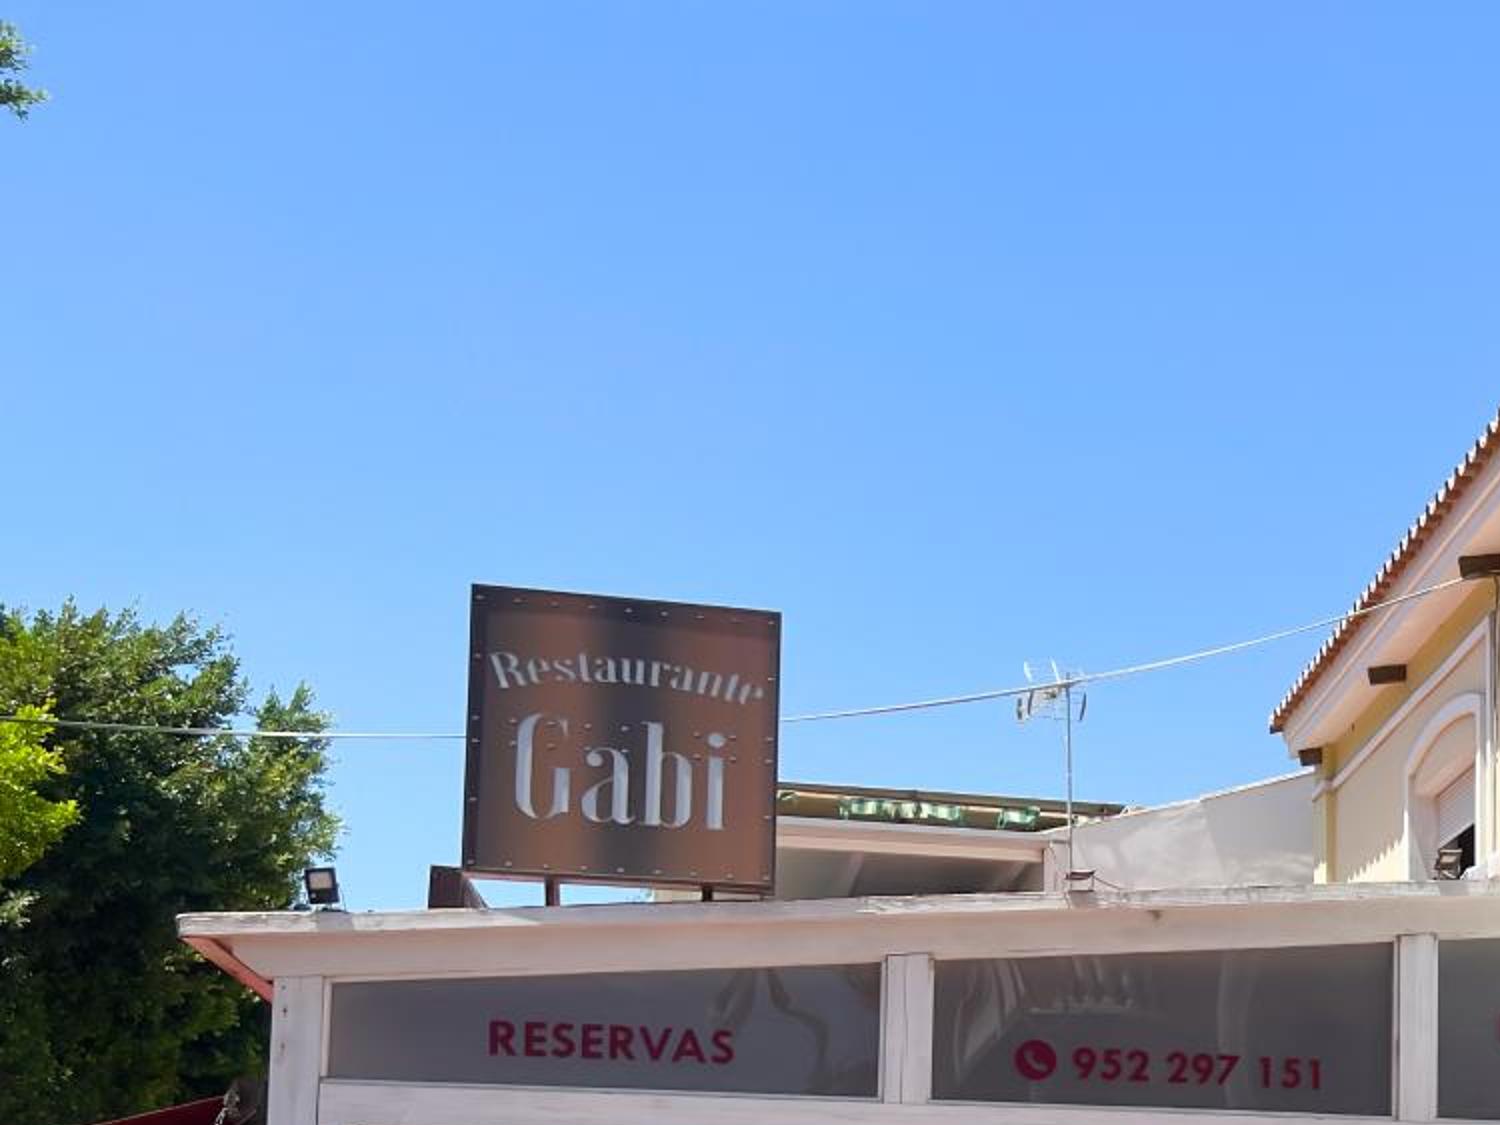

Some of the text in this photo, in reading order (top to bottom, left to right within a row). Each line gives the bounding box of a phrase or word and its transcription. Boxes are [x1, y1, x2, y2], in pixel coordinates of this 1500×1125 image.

[487, 651, 765, 705] Restaurante
[514, 711, 727, 830] Gabi
[487, 1020, 735, 1065] RESERVAS
[1071, 1047, 1324, 1090] 952 297 151
